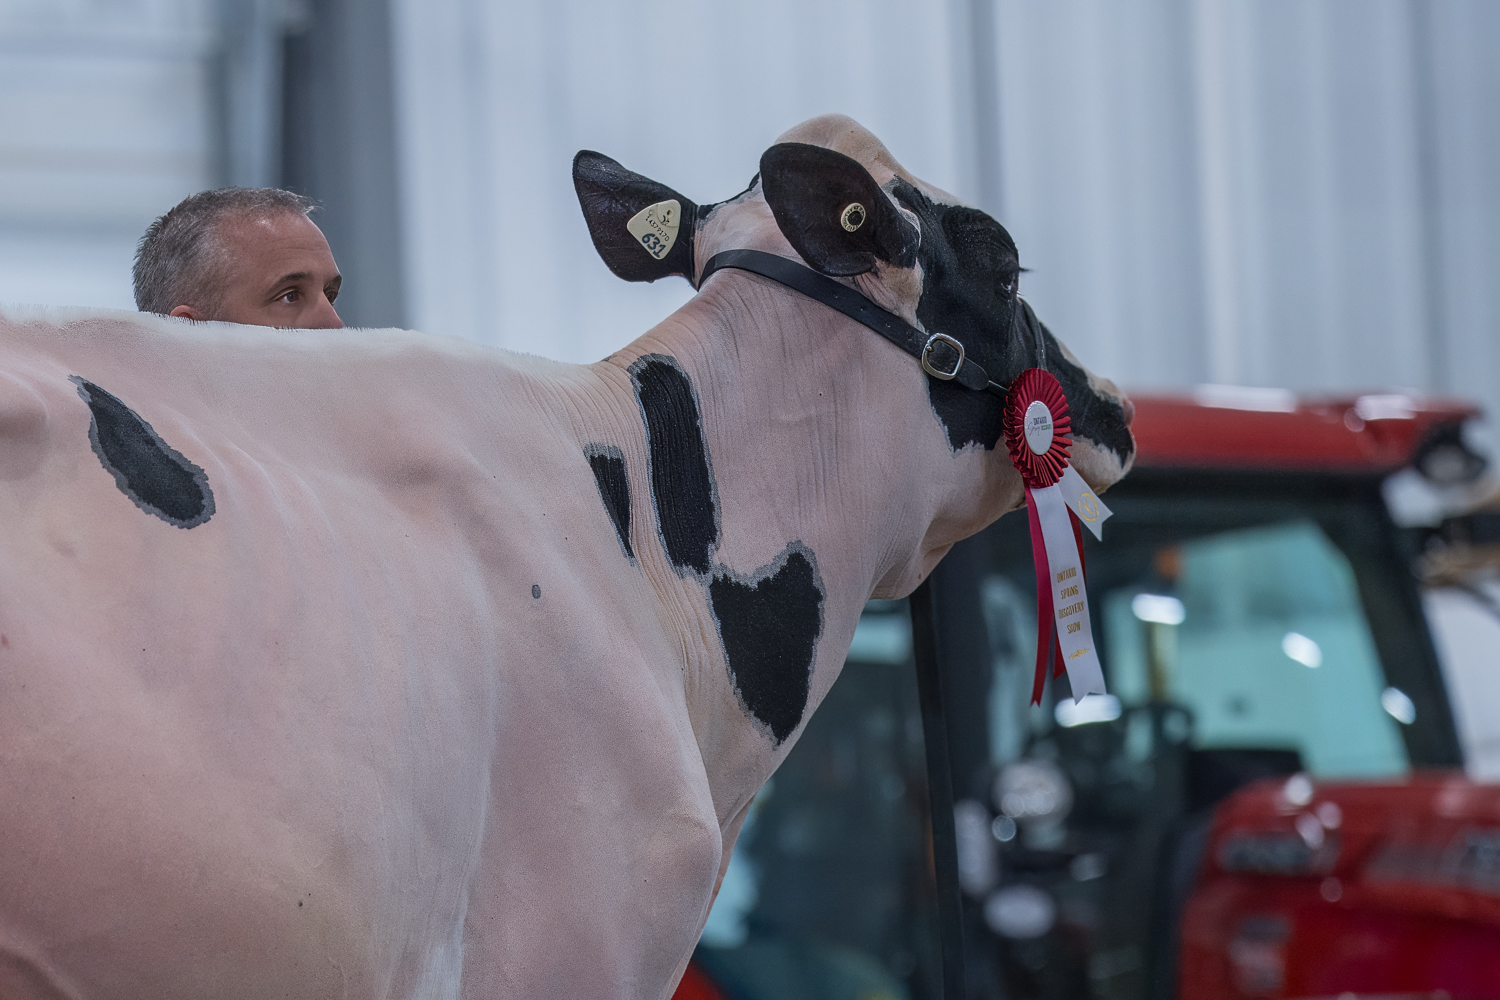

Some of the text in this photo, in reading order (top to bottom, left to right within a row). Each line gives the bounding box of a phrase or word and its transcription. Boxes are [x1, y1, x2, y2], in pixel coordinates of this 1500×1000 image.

[642, 233, 666, 258] 631
[1057, 567, 1077, 583] ONTARIO
[1061, 585, 1079, 599] SPRING
[1058, 601, 1084, 619] DISCOVERY
